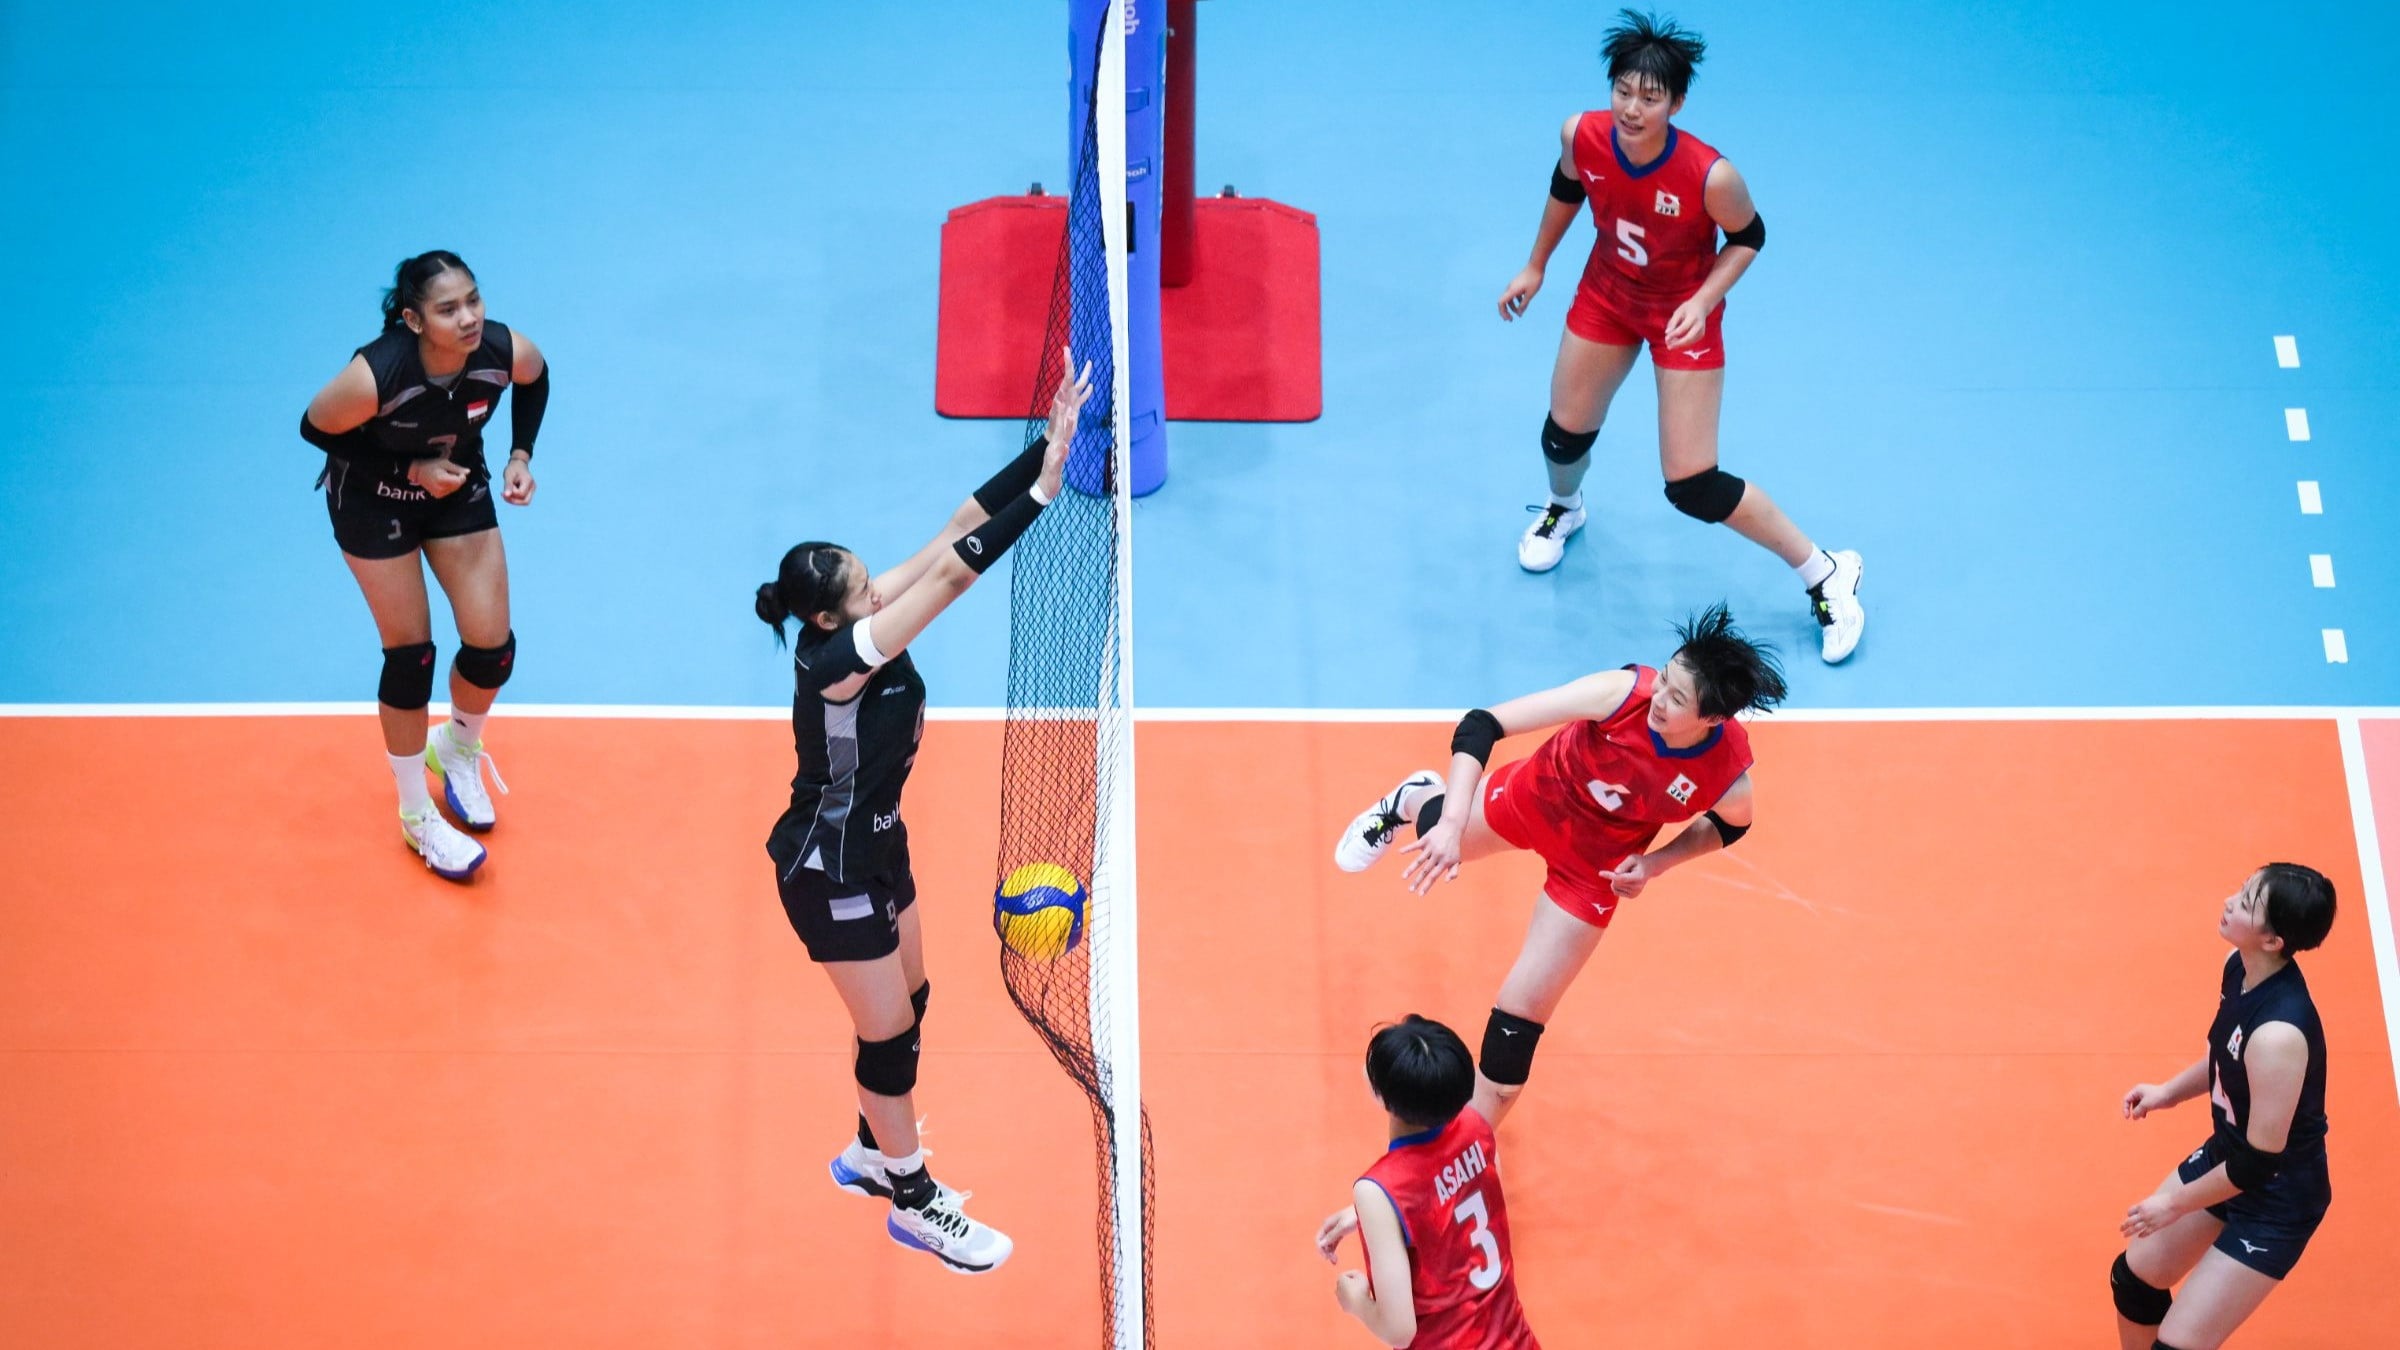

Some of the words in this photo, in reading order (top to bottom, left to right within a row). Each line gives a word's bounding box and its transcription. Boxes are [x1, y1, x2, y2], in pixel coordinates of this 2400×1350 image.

[1125, 0, 1140, 35] oh
[1616, 218, 1648, 267] 5
[377, 481, 426, 501] bank
[1587, 779, 1631, 812] 6
[1434, 1140, 1488, 1205] ASAHI
[1454, 1190, 1502, 1290] 3
